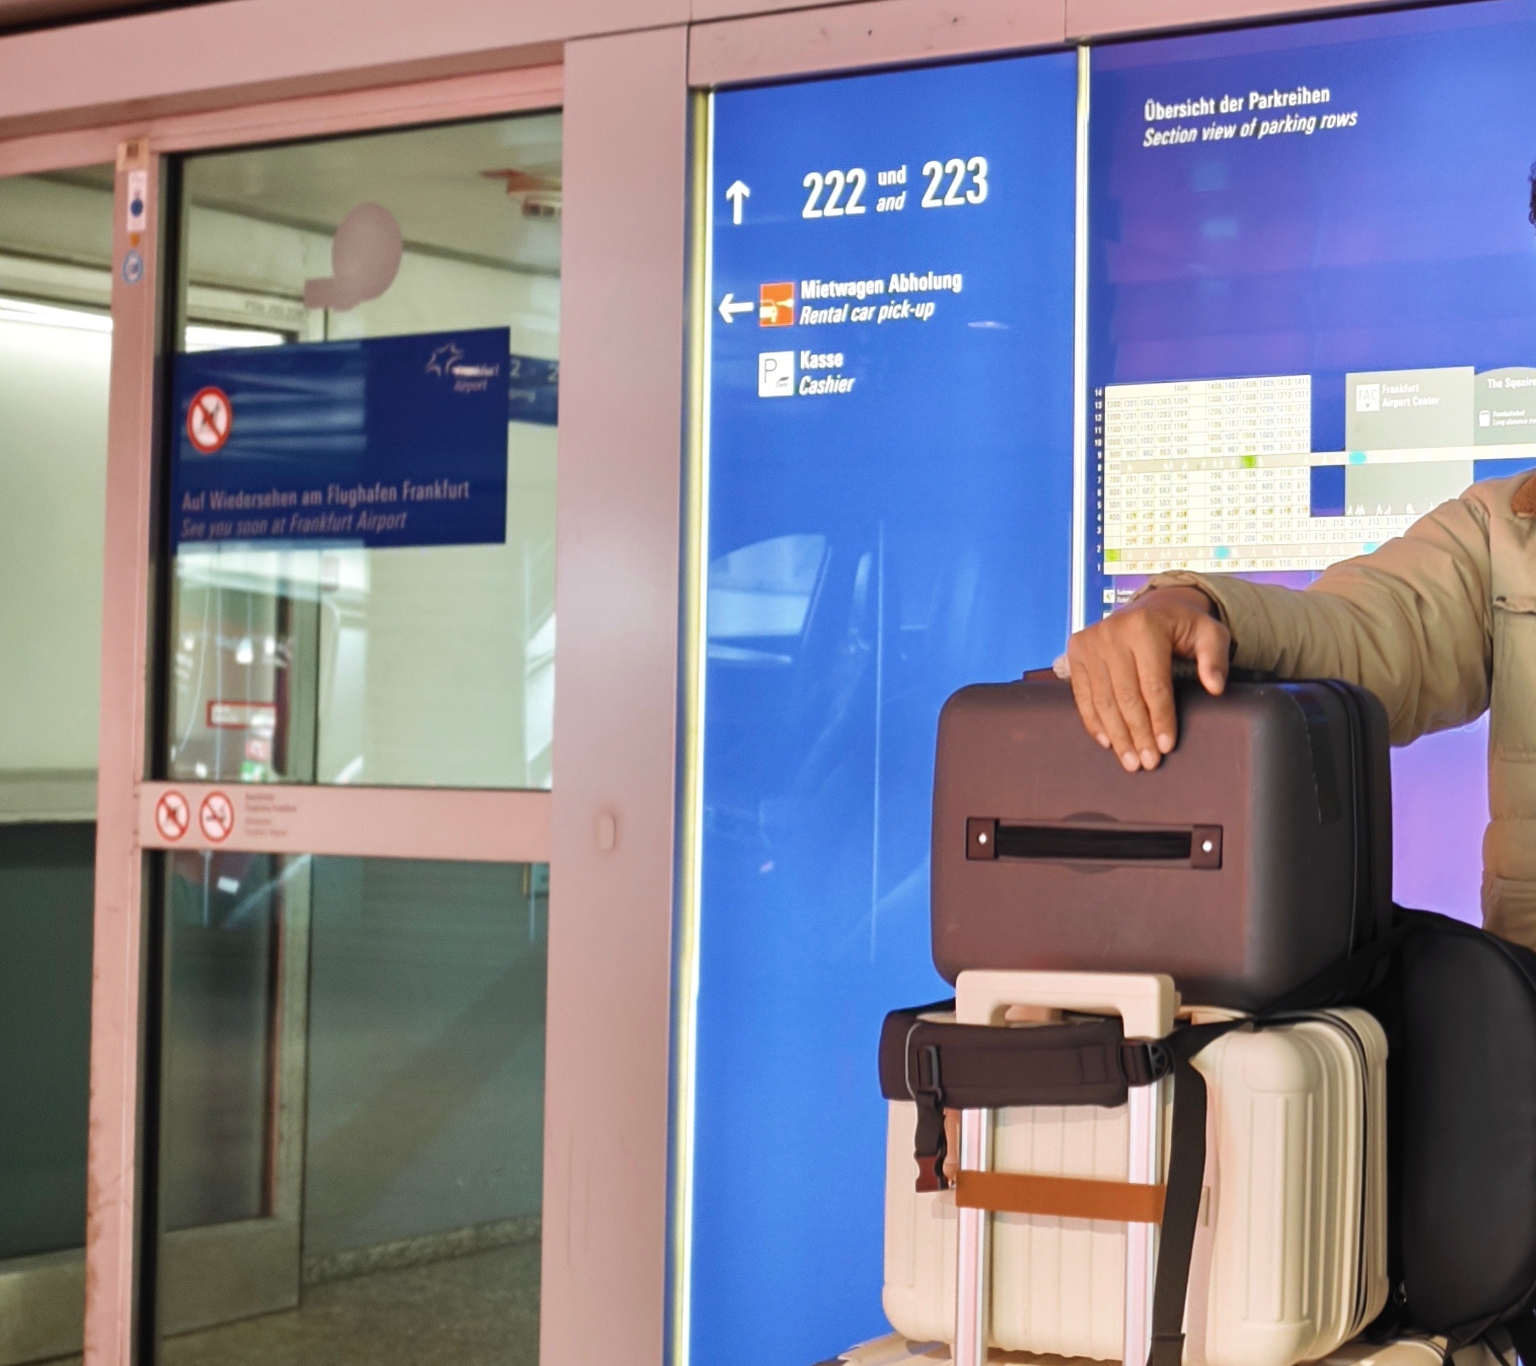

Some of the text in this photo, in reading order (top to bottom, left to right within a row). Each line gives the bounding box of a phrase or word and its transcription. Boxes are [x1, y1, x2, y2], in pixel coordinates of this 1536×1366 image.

[1144, 85, 1330, 121] Übersicht der Parkreihen
[1143, 111, 1358, 148] Section view of parking rows
[802, 156, 988, 219] 222 und 223
[876, 190, 907, 212] and
[801, 271, 962, 300] Mietwagen Abholung
[799, 299, 935, 325] Rental car pick-up
[800, 350, 844, 370] Kasse
[798, 374, 856, 396] Cashier
[1381, 395, 1441, 410] Airport Center
[208, 488, 298, 511] Wiedersehen
[301, 490, 322, 507] am
[327, 481, 398, 509] Flughafen
[402, 479, 470, 502] Frankfurt
[289, 511, 354, 534] Frankfurt
[356, 510, 407, 533] Airport
